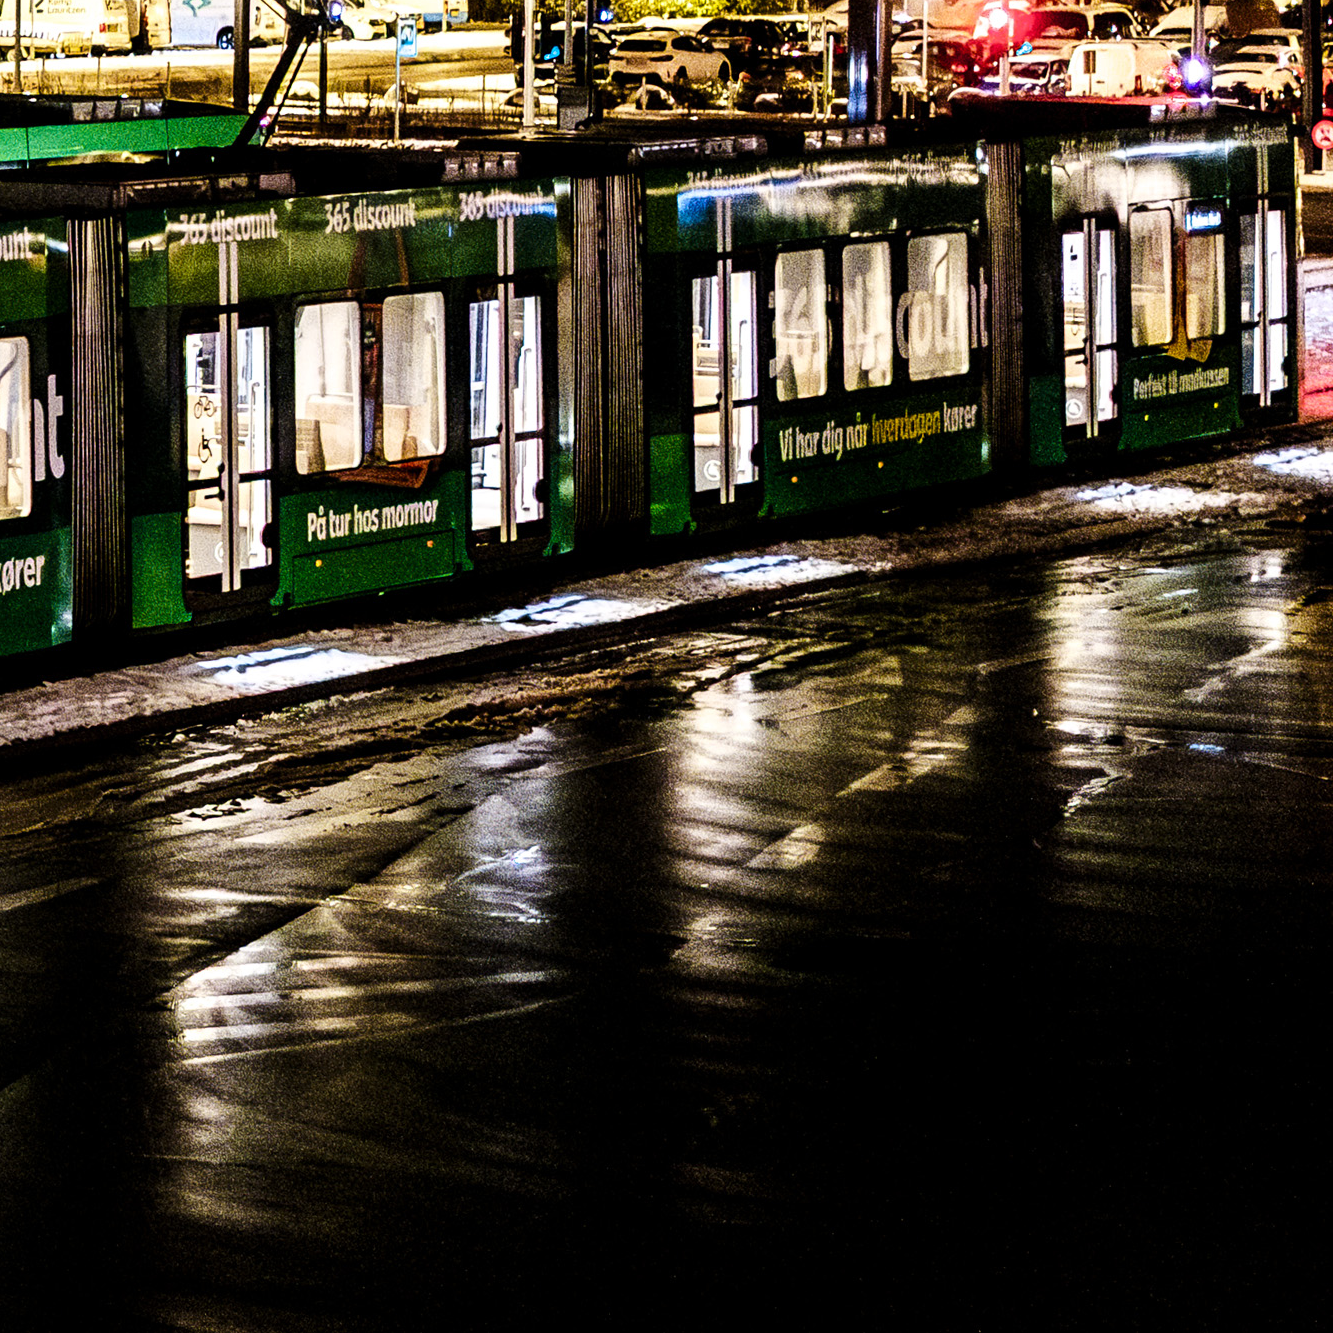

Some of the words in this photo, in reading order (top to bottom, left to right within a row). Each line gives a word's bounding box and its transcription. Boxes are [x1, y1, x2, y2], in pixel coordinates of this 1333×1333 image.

[324, 201, 351, 234] 365
[354, 196, 416, 232] discount
[458, 190, 485, 222] 365
[179, 213, 207, 246] 365
[211, 208, 278, 243] discount
[779, 426, 794, 462] Vi
[796, 426, 820, 459] har
[821, 420, 844, 461] dig
[846, 412, 870, 451] når
[871, 406, 941, 445] hverdagen
[307, 505, 327, 543] På
[329, 509, 352, 539] tur
[354, 503, 380, 535] hos
[381, 499, 439, 530] mormor
